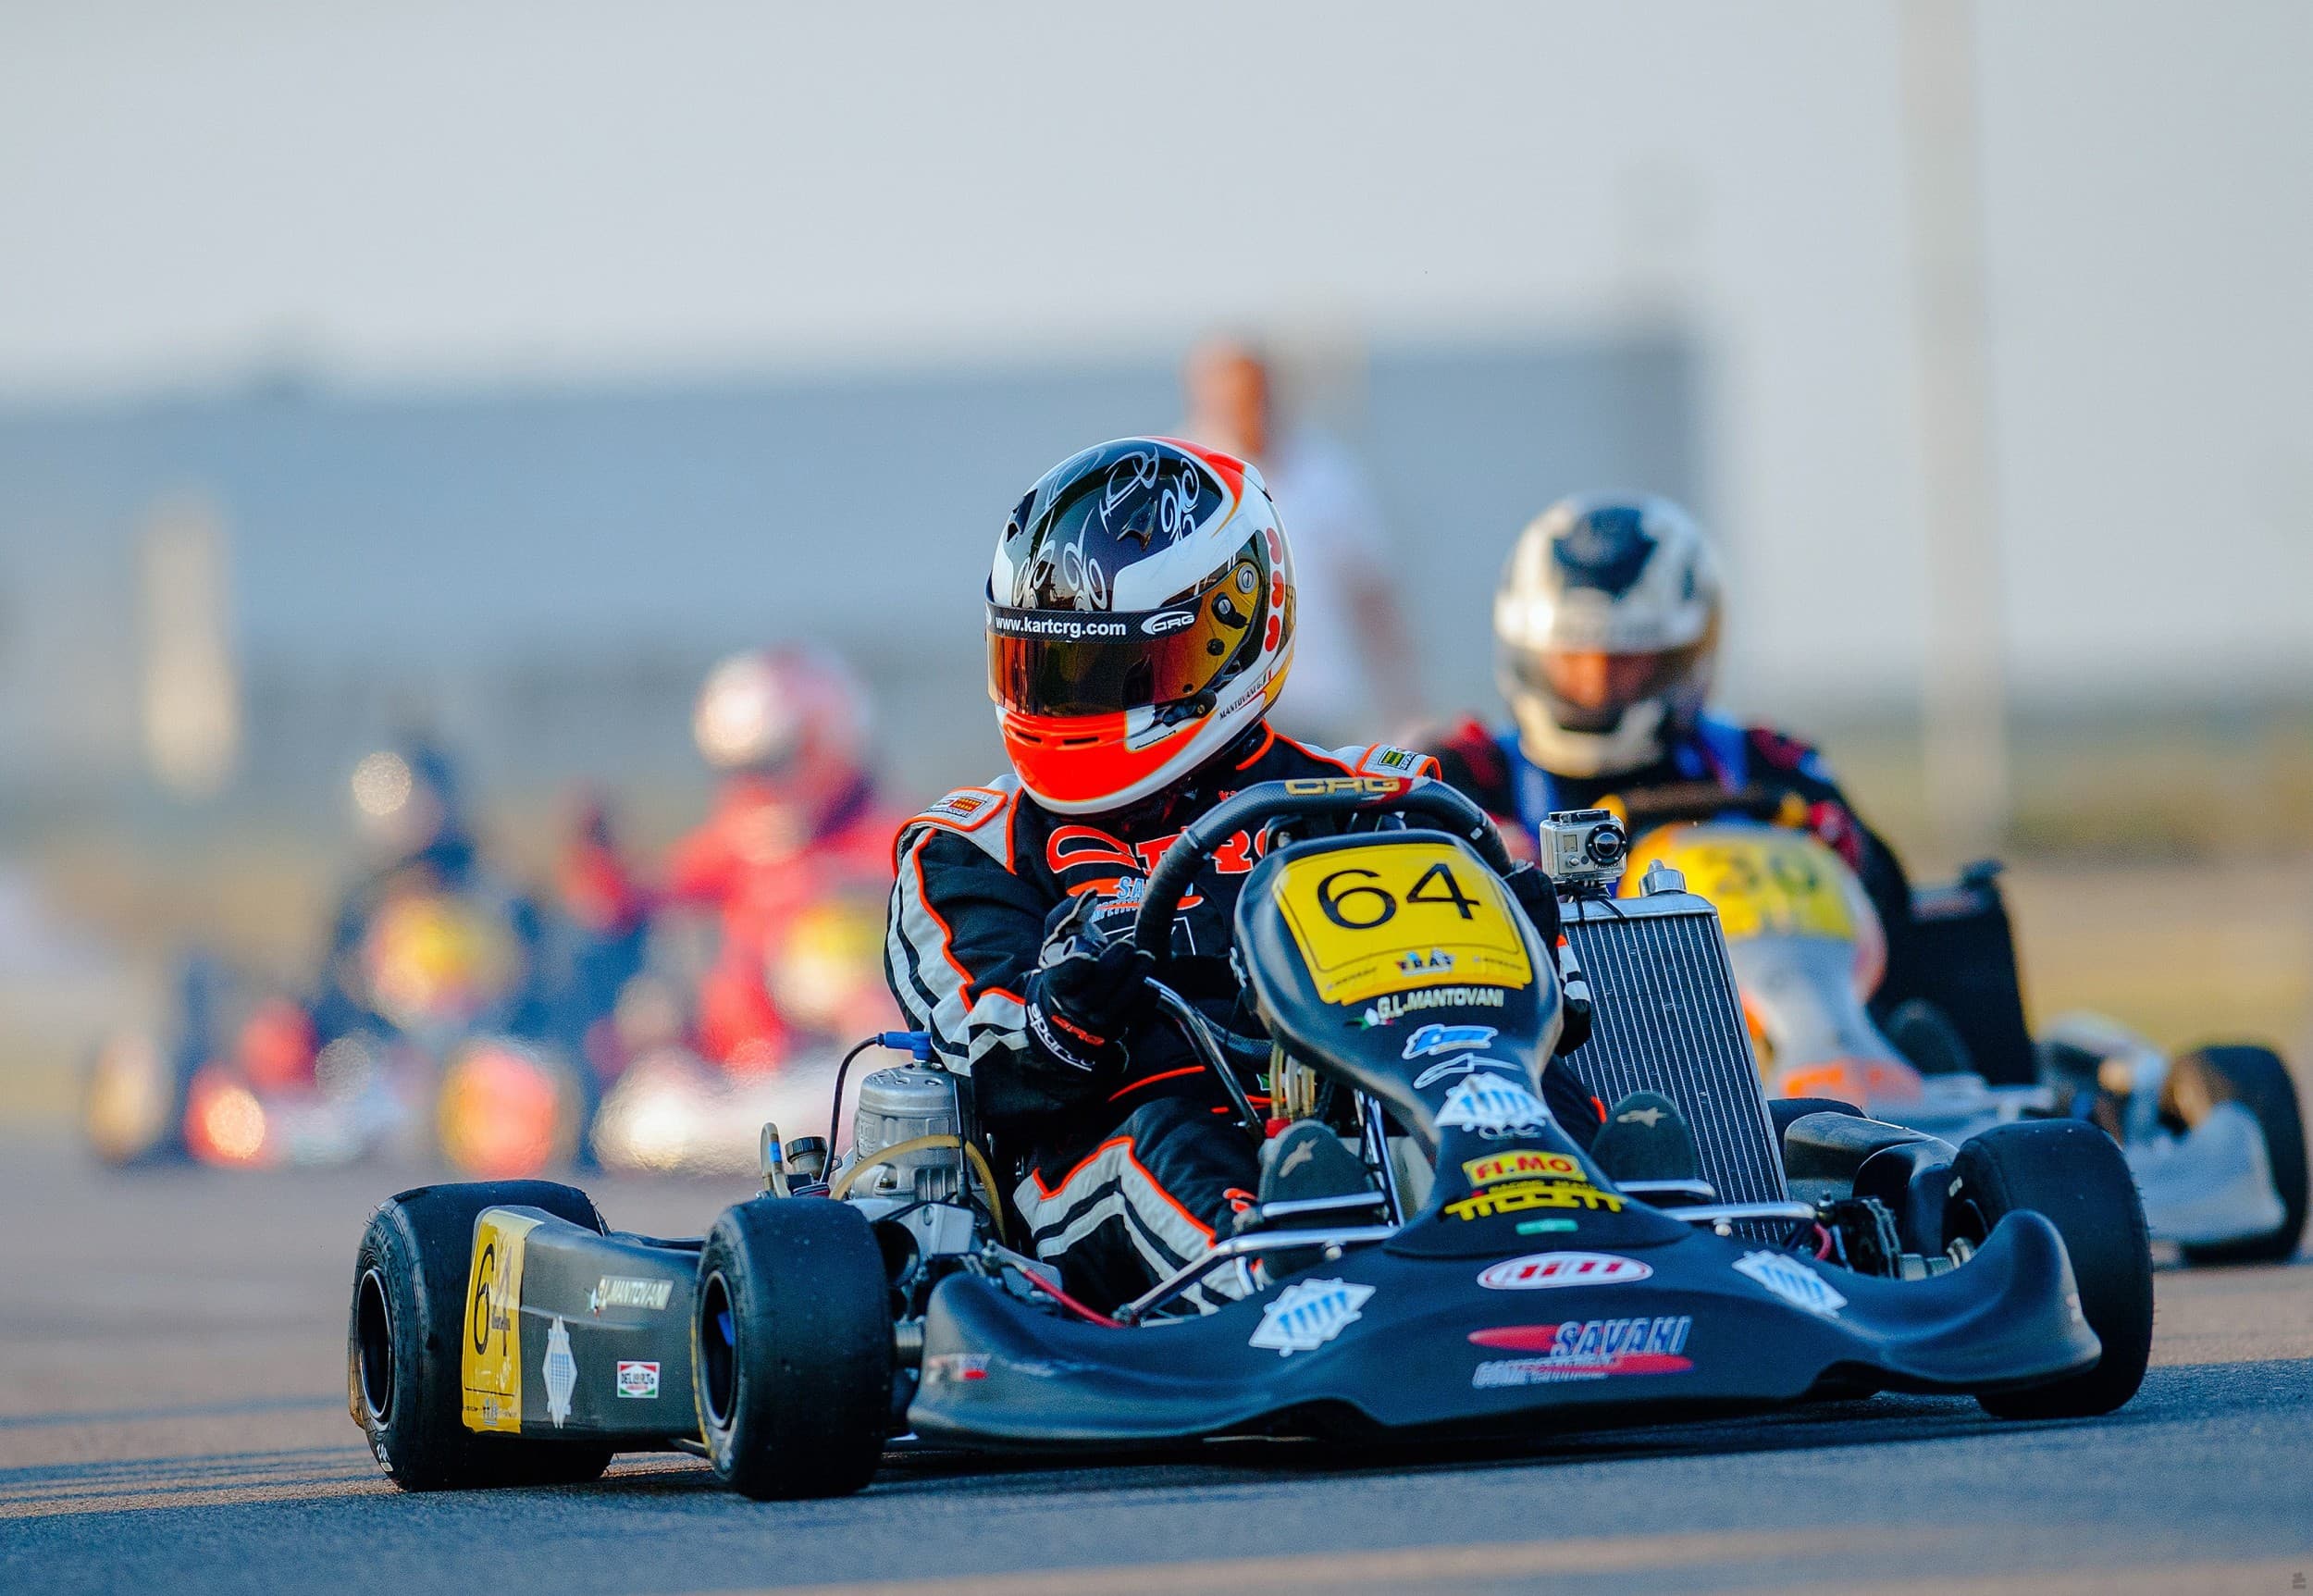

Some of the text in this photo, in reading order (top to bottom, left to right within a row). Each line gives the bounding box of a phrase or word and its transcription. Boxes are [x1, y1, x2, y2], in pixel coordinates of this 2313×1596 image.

[995, 616, 1127, 638] www.kartcrg.com
[1151, 614, 1196, 633] CRG
[1284, 777, 1401, 797] CRG
[1317, 862, 1480, 930] 64
[1475, 1155, 1573, 1181] FI.MO
[473, 1243, 512, 1357] 64
[1550, 1314, 1694, 1358] SAVANI
